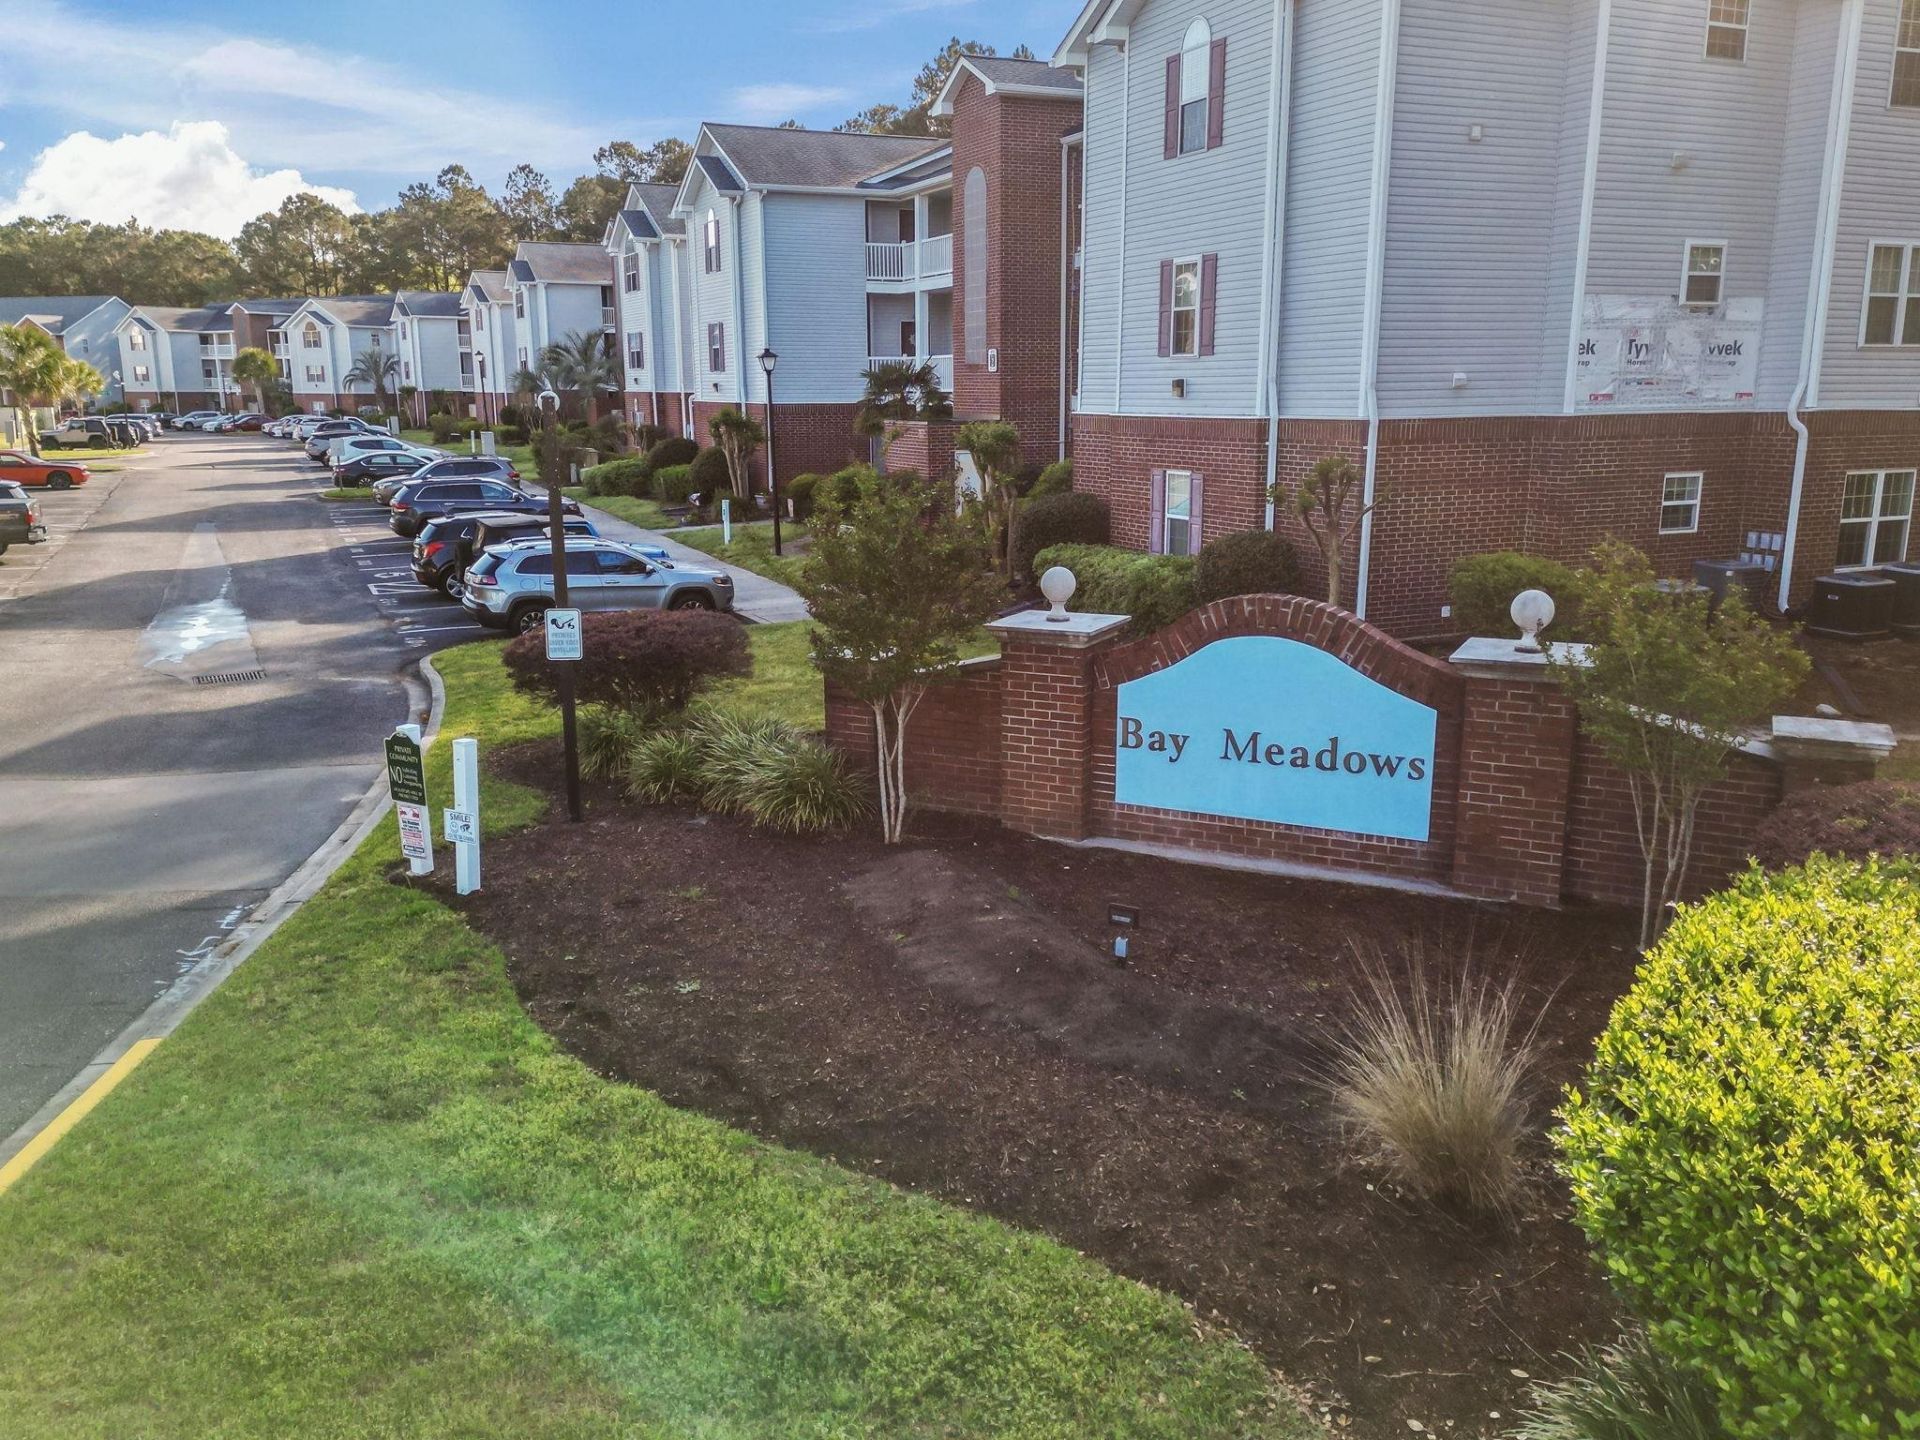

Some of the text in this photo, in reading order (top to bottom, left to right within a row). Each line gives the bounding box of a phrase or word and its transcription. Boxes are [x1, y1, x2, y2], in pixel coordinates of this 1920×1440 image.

[1119, 716, 1426, 781] Bay Meadows
[389, 764, 403, 784] NO
